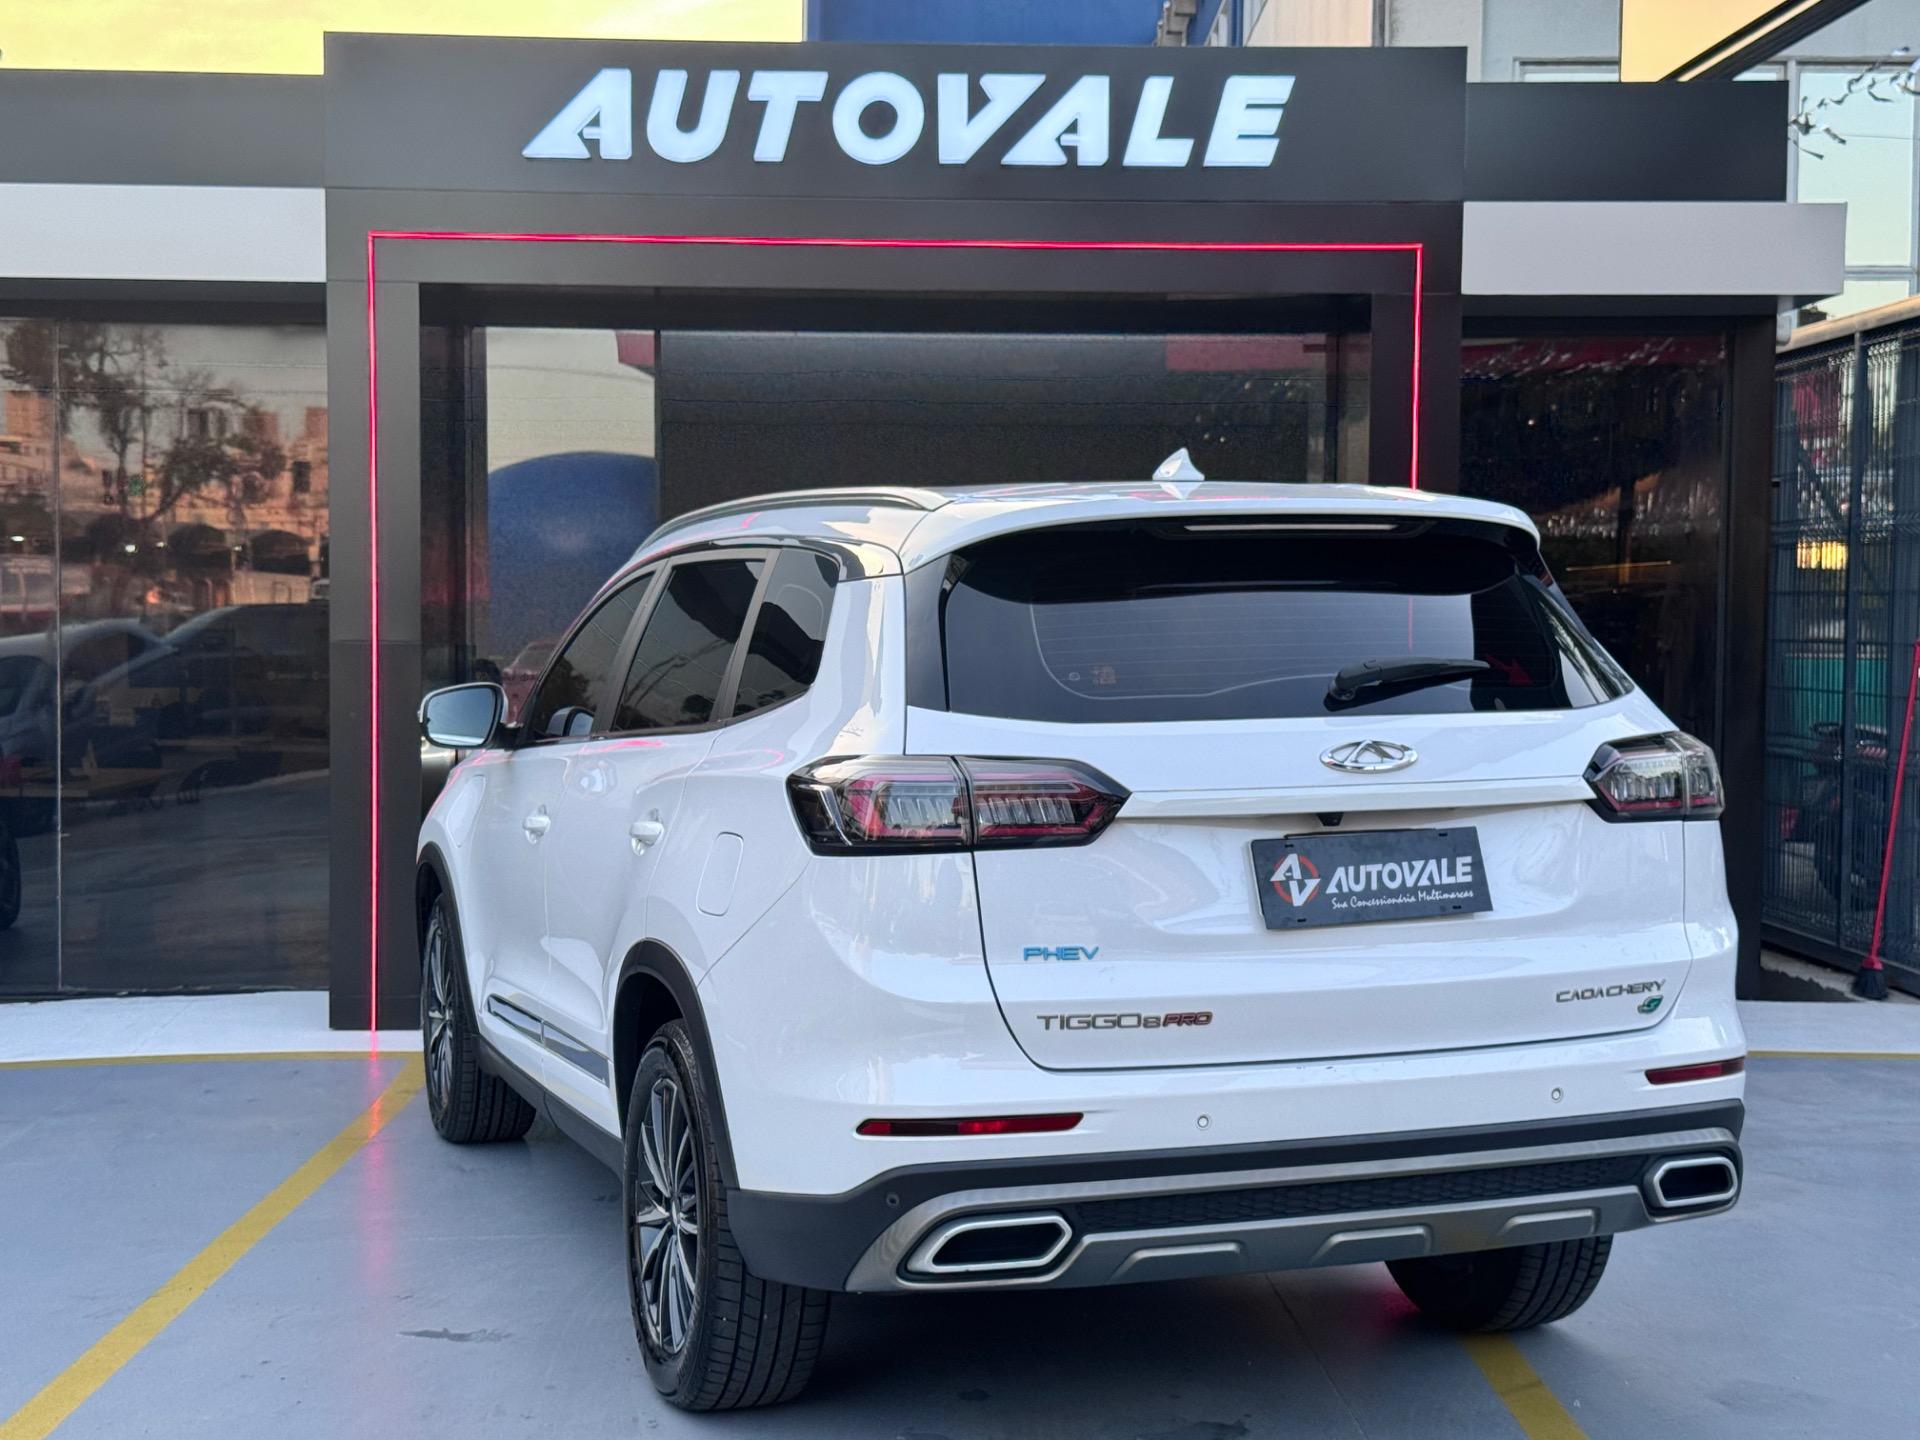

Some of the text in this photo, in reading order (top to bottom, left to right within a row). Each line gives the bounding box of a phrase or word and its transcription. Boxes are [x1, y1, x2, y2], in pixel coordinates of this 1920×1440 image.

[521, 67, 1296, 168] AUTOVALE
[1325, 856, 1473, 895] AUTOVALE
[1331, 897, 1349, 909] Sua
[1418, 889, 1474, 901] Multimarcas
[1023, 946, 1100, 961] PHEV
[1605, 979, 1666, 997] CHERY
